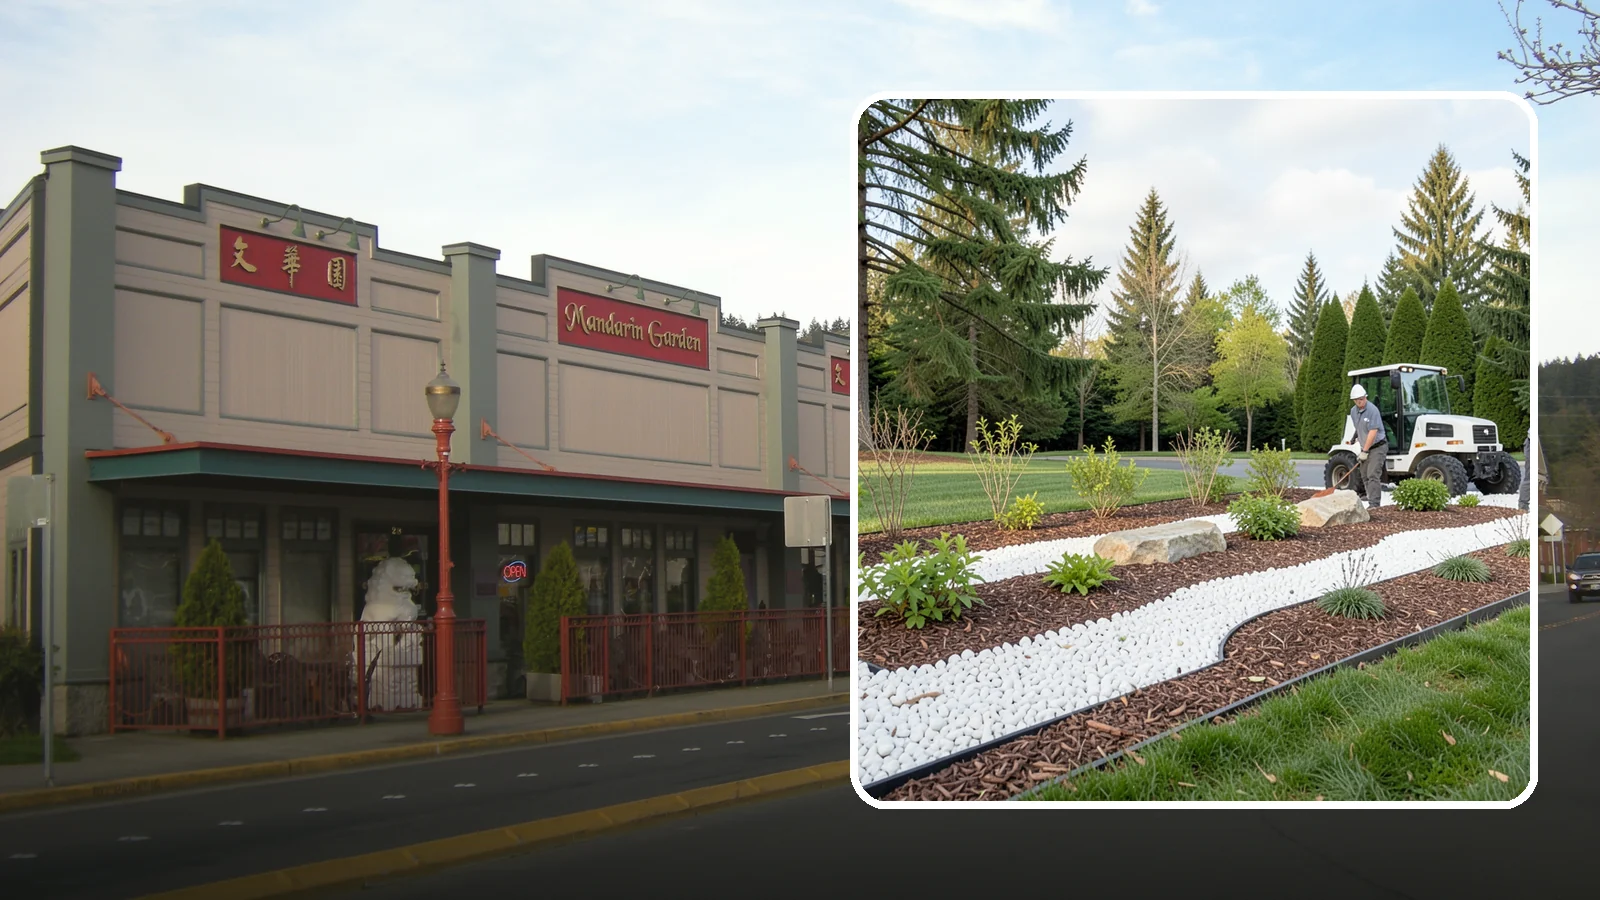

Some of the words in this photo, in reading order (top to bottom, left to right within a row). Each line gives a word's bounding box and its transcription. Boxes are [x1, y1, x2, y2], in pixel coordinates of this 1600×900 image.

[230, 235, 347, 291] 文華園
[564, 302, 644, 341] Mandarin
[647, 320, 702, 352] Garden
[503, 565, 527, 578] OPEN
